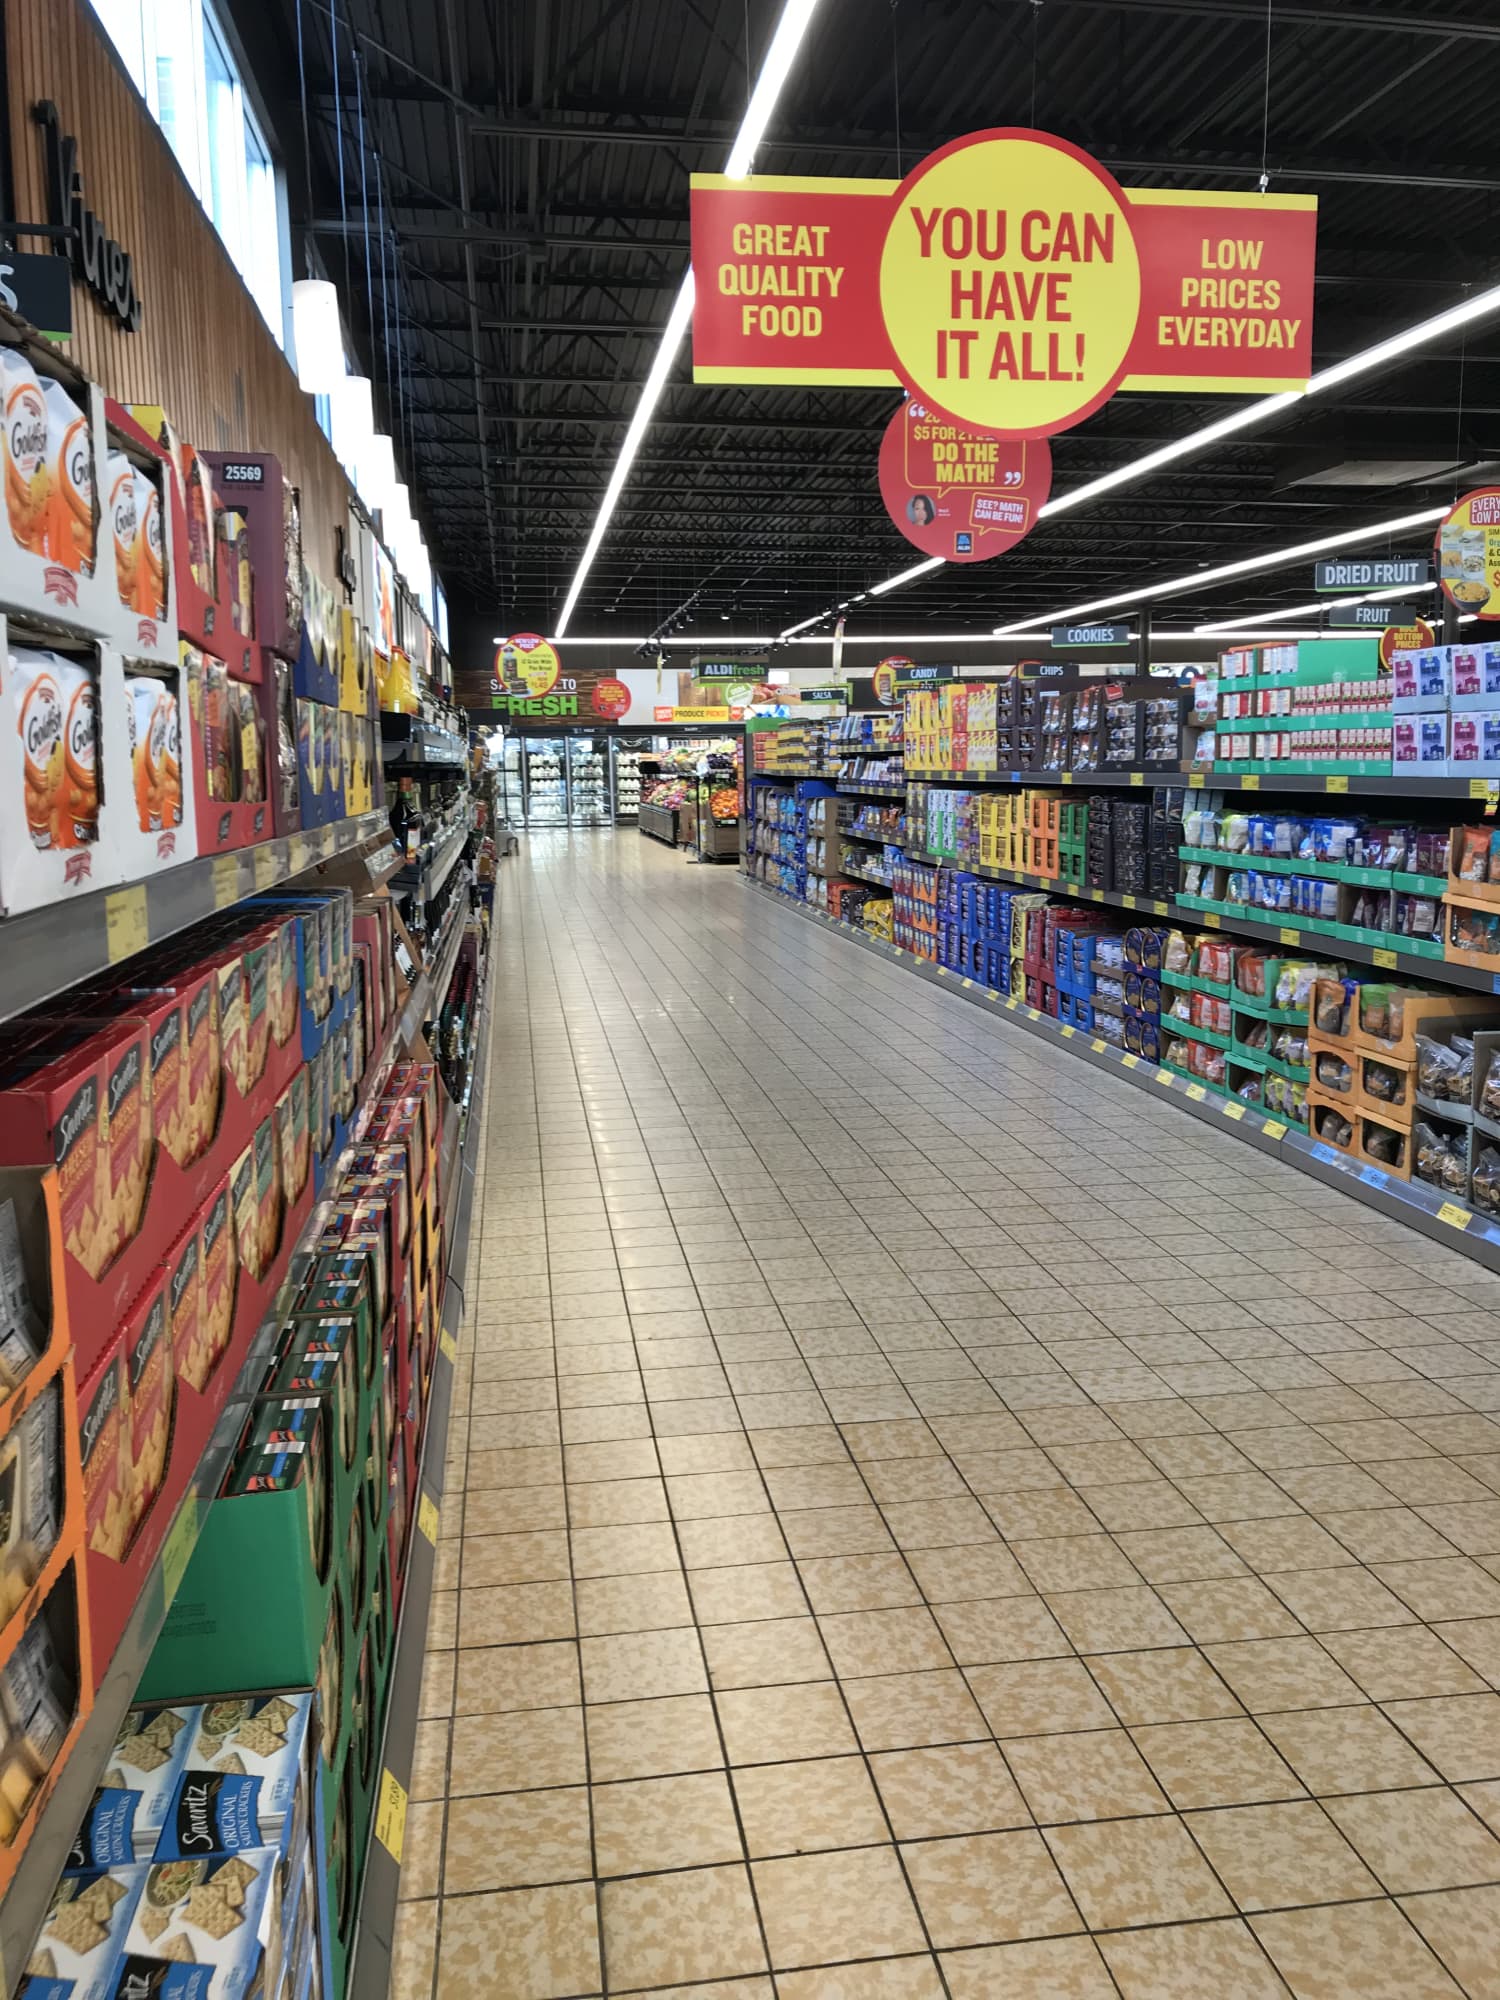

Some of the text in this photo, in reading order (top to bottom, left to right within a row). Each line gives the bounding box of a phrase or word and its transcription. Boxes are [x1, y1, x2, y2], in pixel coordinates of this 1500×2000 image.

[733, 223, 830, 257] GREAT
[910, 206, 1115, 264] YOU CAN
[1201, 238, 1264, 271] LOW
[718, 263, 845, 298] QUALITY
[950, 270, 1072, 322] HAVE
[1182, 277, 1281, 310] PRICES
[742, 304, 823, 337] FOOD
[1158, 318, 1301, 349] EVERYDAY
[936, 329, 1086, 382] IT ALL!
[914, 424, 930, 441] $5
[931, 426, 956, 441] FOR
[932, 443, 999, 462] DO THE
[225, 465, 262, 481] 25569
[936, 463, 995, 483] MATH!
[974, 509, 992, 519] CAN
[992, 511, 1004, 521] BE
[977, 499, 1024, 513] SEE? MATH
[1471, 511, 1492, 525] LOW
[1325, 563, 1419, 585] DRIED FRUIT
[1356, 608, 1391, 623] FRUIT
[1067, 628, 1114, 642] COOKIES
[704, 664, 765, 676] ALDIfresh
[910, 668, 938, 678] CANDY
[1039, 665, 1064, 676] CHIPS
[561, 679, 576, 690] TO
[812, 691, 832, 699] SALSA
[492, 695, 578, 716] FRESH
[675, 710, 704, 718] PRODUCE
[182, 1782, 214, 1850] Savoritz
[221, 1794, 240, 1848] ORIGINAL
[237, 1781, 253, 1847] SALTINE CRACKERS
[95, 1808, 114, 1864] ORIGINAL
